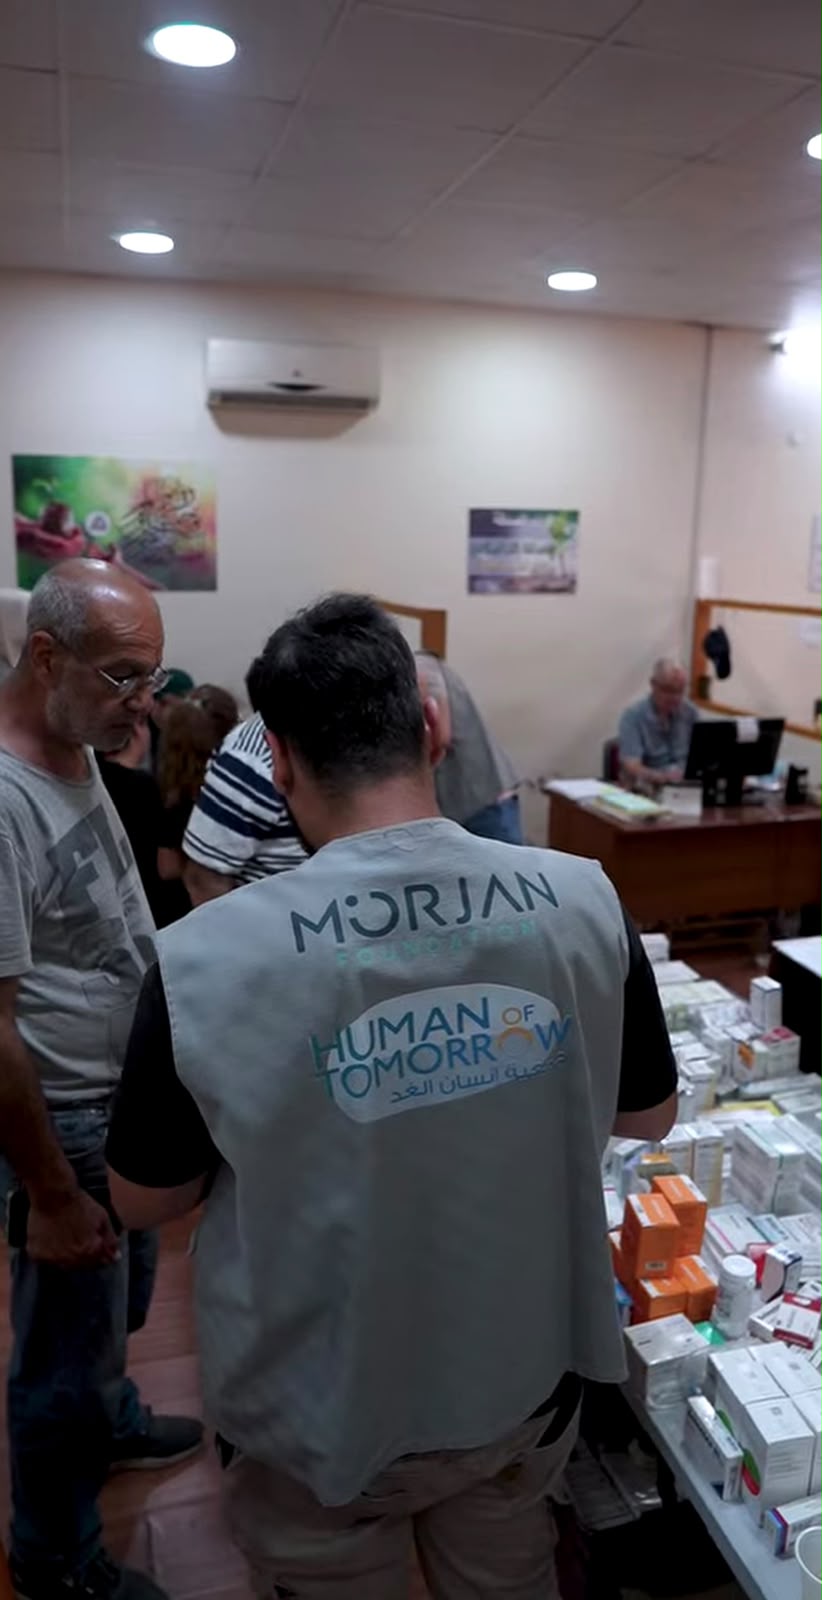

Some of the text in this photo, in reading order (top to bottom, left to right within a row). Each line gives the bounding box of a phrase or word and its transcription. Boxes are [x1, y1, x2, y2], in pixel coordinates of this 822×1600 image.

[290, 871, 559, 953] MORJAN
[309, 997, 535, 1071] HUMAN OF
[313, 1014, 572, 1098] TOMORROW
